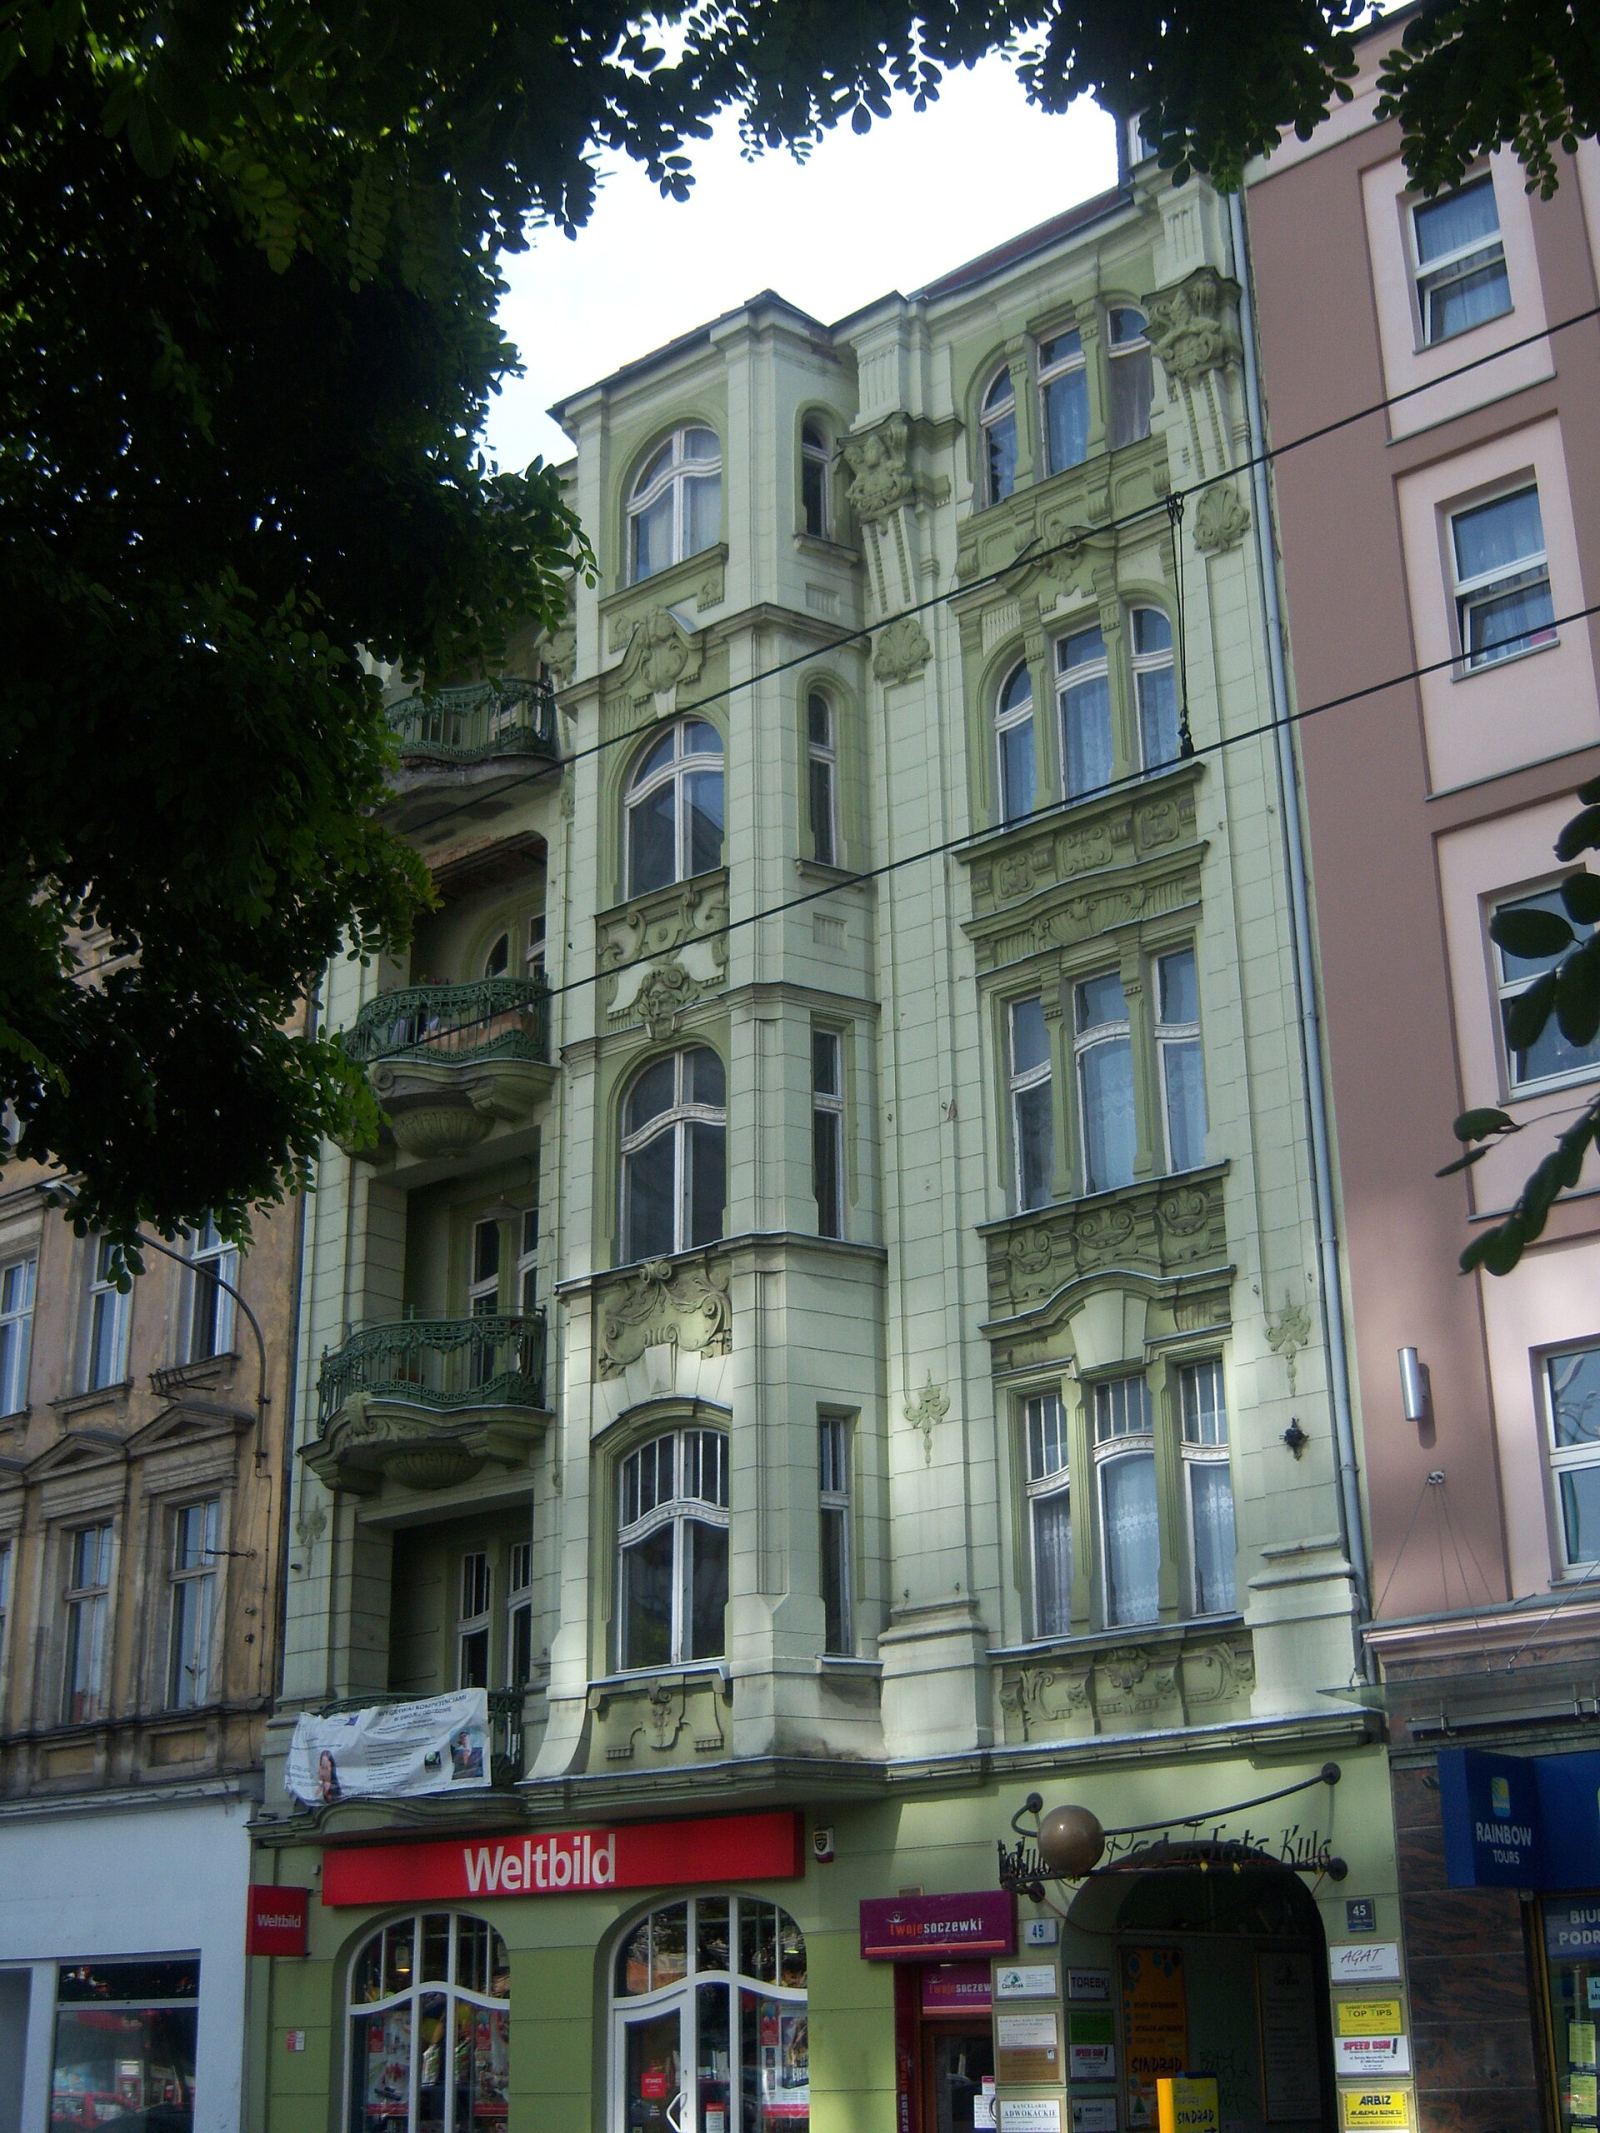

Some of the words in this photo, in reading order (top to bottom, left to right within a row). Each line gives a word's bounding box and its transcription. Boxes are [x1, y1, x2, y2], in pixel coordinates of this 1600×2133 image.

[1475, 1822, 1532, 1847] RAINBOW
[463, 1833, 616, 1893] Weltbild
[1493, 1849, 1521, 1865] TOURS
[1352, 1904, 1367, 1917] 45
[256, 1913, 302, 1929] Weltbild
[1031, 1924, 1045, 1939] 45
[1340, 1947, 1385, 1966] AGAT
[1347, 2010, 1367, 2018] TOP
[1370, 2008, 1393, 2017] TIPS
[1131, 2055, 1183, 2074] SINDBAD
[1359, 2095, 1392, 2106] ARBIZ
[1004, 2109, 1056, 2118] ADWOKACKIE
[1176, 2109, 1215, 2125] SINDBAD
